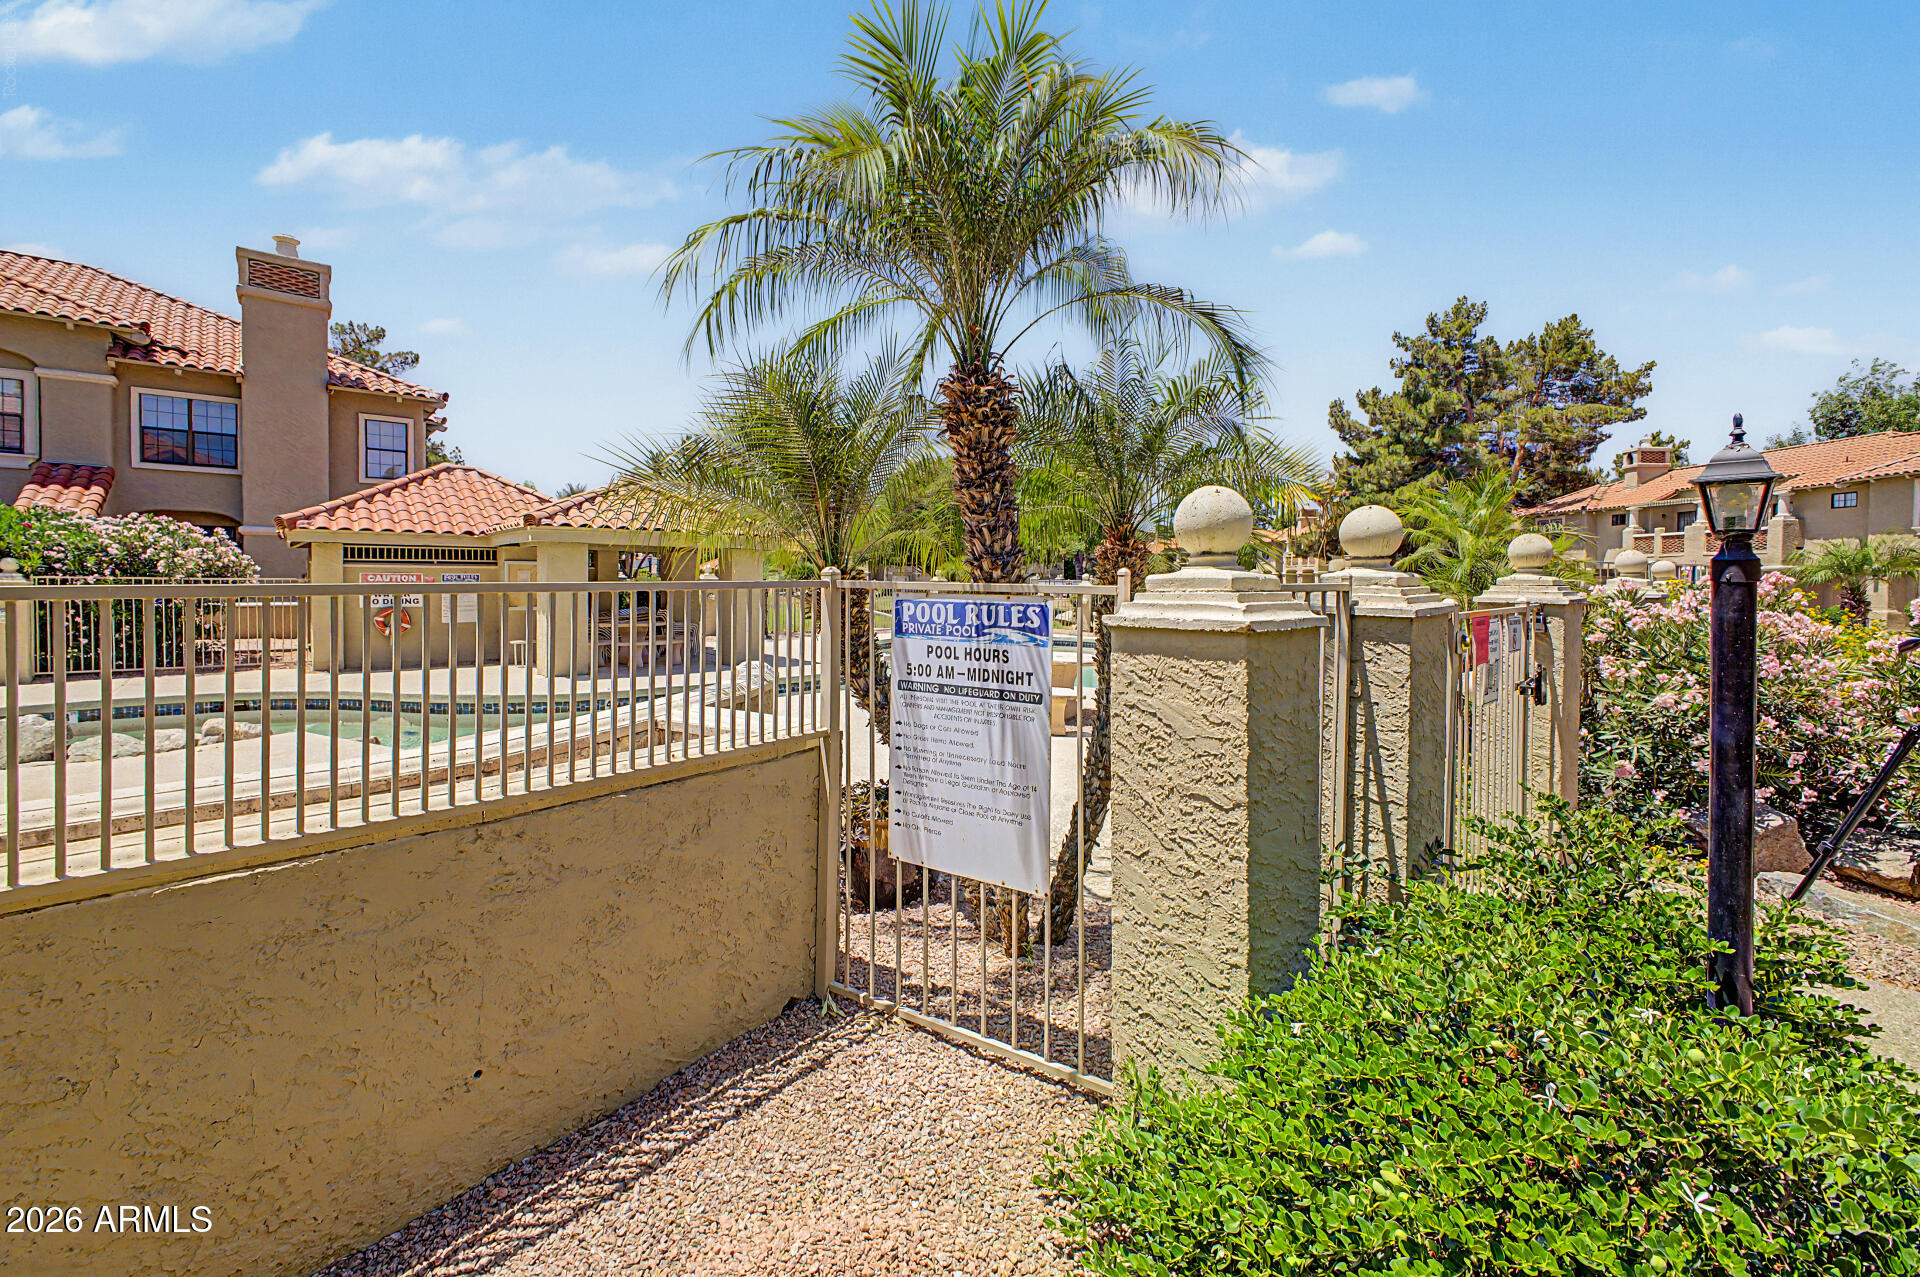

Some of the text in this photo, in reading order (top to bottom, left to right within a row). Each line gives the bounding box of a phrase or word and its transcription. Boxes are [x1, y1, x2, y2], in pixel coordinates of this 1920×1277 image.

[368, 574, 417, 582] CAUTION
[902, 602, 1041, 628] POOL RULES
[902, 624, 978, 637] PRIVATE POOL
[926, 645, 1010, 664] POOL HOURS
[906, 664, 932, 677] 5:00
[900, 681, 1040, 702] WARNING NO LIFEGUARD ON DUTY
[961, 700, 977, 708] POOL
[914, 722, 928, 730] Dogs
